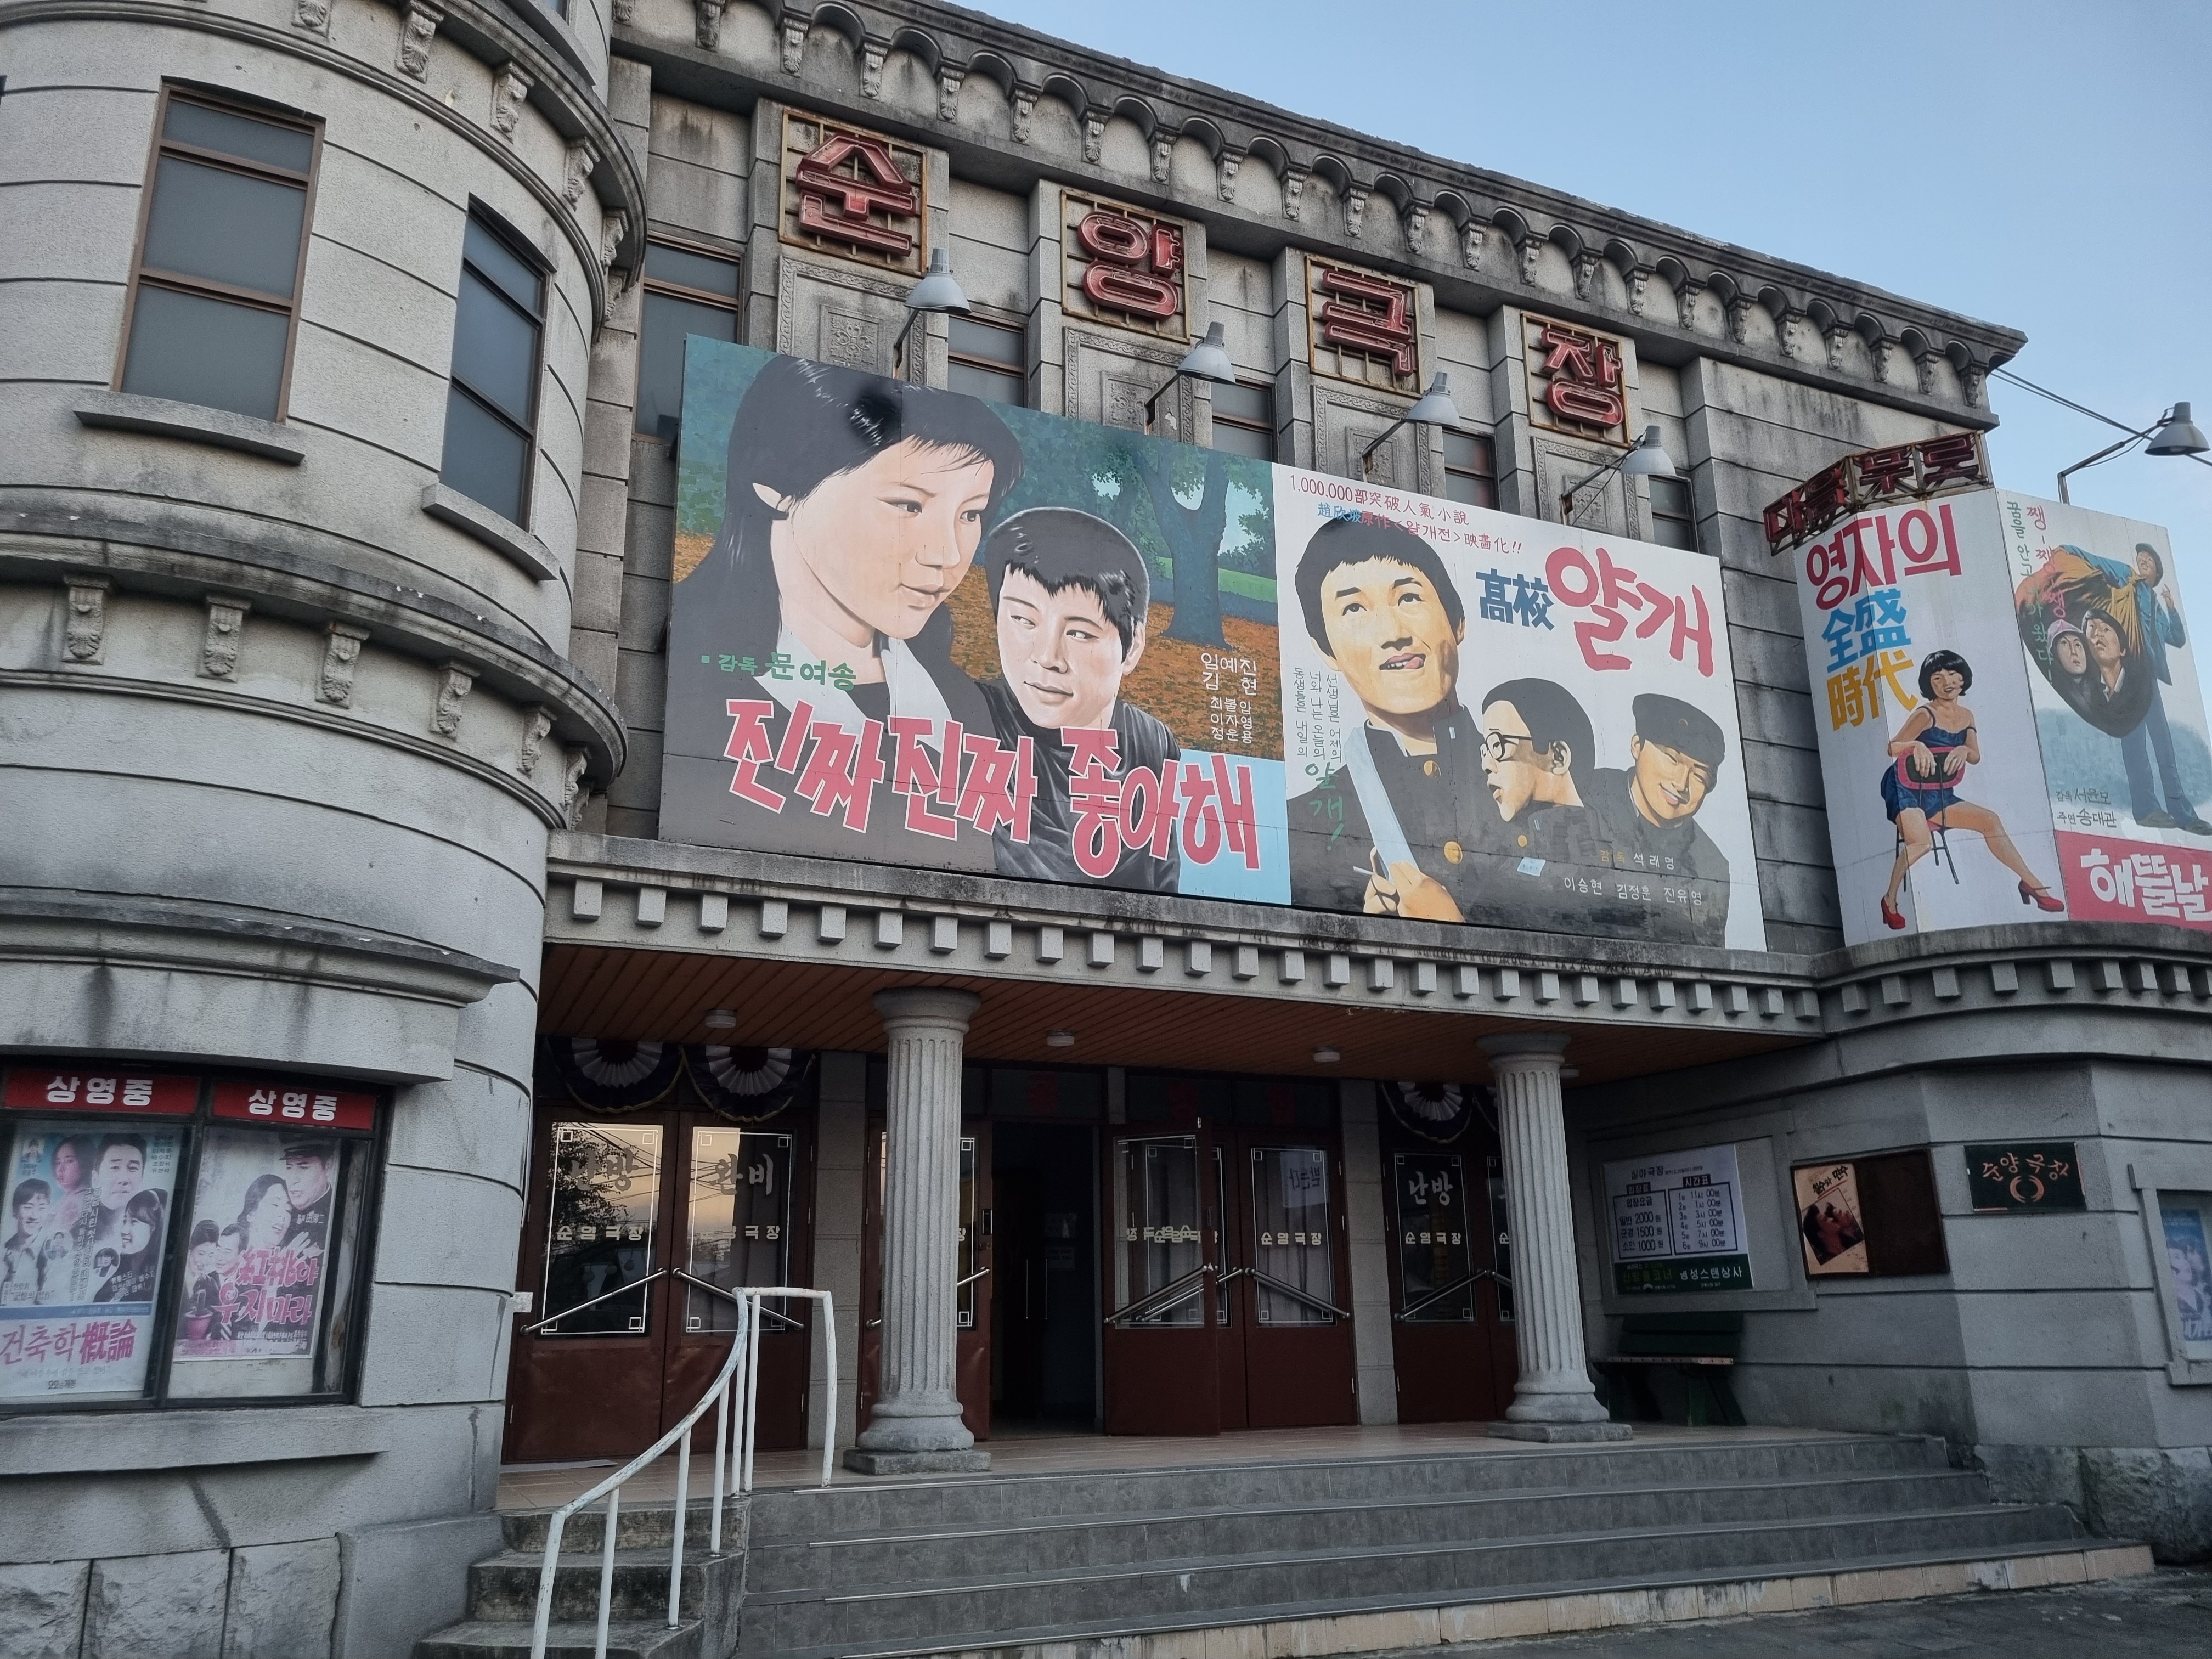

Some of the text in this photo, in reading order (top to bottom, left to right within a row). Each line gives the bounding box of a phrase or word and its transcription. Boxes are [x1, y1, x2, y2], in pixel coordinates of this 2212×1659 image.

[2007, 500, 2026, 539] 꿈을
[1805, 504, 1963, 611] 영자의
[1545, 546, 1714, 678] 얄개
[1821, 588, 1912, 674] 全盛
[718, 651, 857, 691] 감독 문여송
[1201, 652, 1256, 676] 임예진
[1210, 696, 1252, 715] 최불암
[1826, 650, 1918, 731] 時代
[1210, 712, 1252, 730] 이자영
[1293, 667, 1308, 758] 동생들은 내일의
[1310, 671, 1325, 761] 너와 나는 오늘의
[1325, 673, 1342, 763] 선생님은 어제의
[1211, 726, 1253, 744] 정운용
[1060, 726, 1261, 878] 좋아해
[2057, 808, 2117, 828] 주연 송대관
[1599, 849, 1675, 871] 감독 석래명
[1564, 877, 1702, 906] 이승현 김정훈 진유영
[2080, 848, 2212, 922] 해뜰날
[46, 1075, 154, 1107] 상영중
[247, 1087, 338, 1122] 상영중
[1408, 1170, 1454, 1206] 난방
[1685, 1175, 1709, 1187] 시간표
[1634, 1211, 1654, 1224] 2000
[1637, 1225, 1654, 1238] 1500
[1638, 1239, 1656, 1251] 1000
